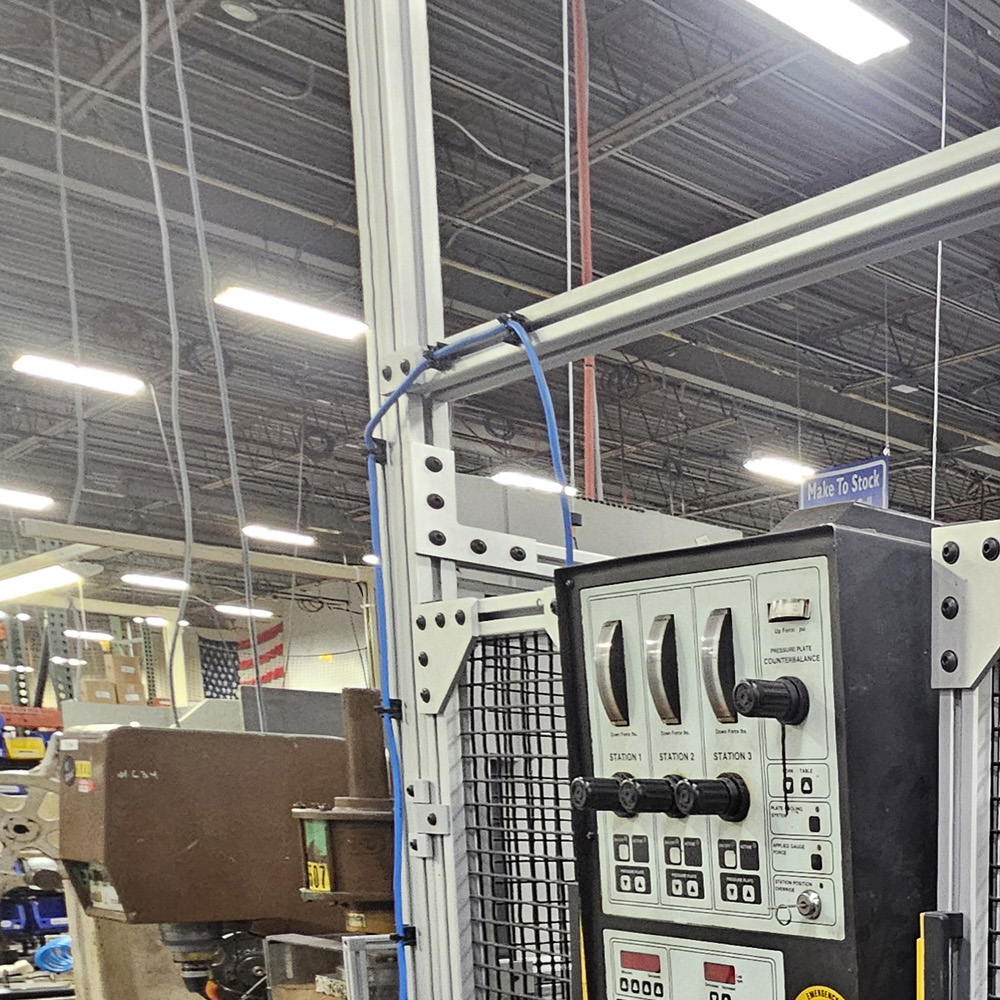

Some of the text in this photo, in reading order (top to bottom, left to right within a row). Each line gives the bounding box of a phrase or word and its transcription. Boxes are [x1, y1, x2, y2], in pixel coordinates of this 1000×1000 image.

[807, 469, 880, 501] Make To Stock
[770, 644, 812, 654] PRESSURE PLATE
[763, 654, 820, 665] COUNTERBALANCE
[609, 753, 643, 762] STATION 1
[659, 752, 695, 761] STATION 2
[713, 751, 753, 761] STATION 3
